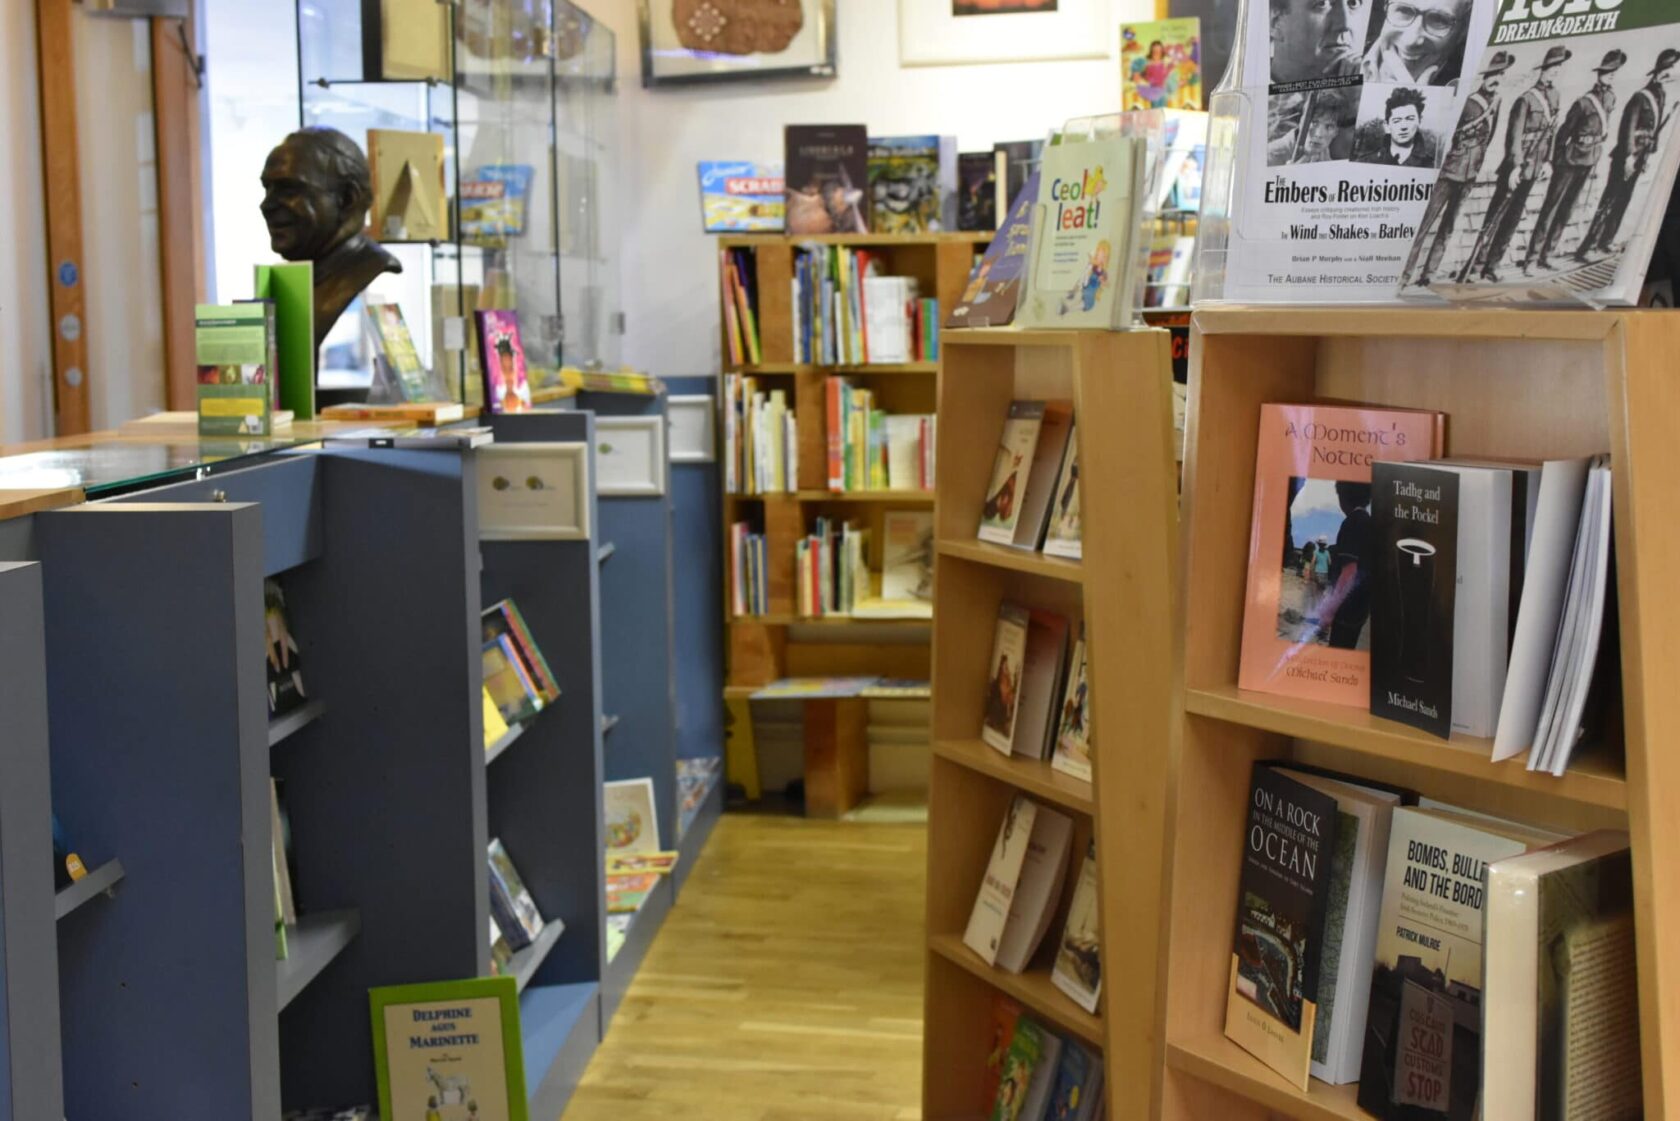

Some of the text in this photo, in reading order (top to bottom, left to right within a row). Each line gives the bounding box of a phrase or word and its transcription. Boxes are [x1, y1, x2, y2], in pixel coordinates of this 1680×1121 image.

[1494, 10, 1619, 43] DREAM&DEATH
[1052, 169, 1088, 201] Ceol
[1264, 181, 1328, 203] Embers
[1057, 200, 1100, 231] leat!
[1290, 224, 1319, 240] Wind
[1329, 224, 1370, 240] Shakes
[1379, 223, 1417, 241] Barley
[1268, 273, 1399, 284] THE AUBANE HISTORICAL SOCIETY
[1303, 422, 1406, 446] Moment's
[1393, 480, 1440, 502] Tadhg and
[1394, 504, 1410, 519] the
[1388, 691, 1438, 719] Michael Sands
[1255, 788, 1320, 837] ON A ROCK
[1251, 825, 1316, 880] OCEAN
[1407, 840, 1449, 874] BOMBS,
[1403, 866, 1428, 891] AND
[1430, 873, 1451, 899] THE
[1396, 926, 1418, 942] PATRICK
[413, 1008, 472, 1022] DELPHINE
[409, 1034, 480, 1049] MARINETTE
[1407, 1071, 1441, 1102] STOP
